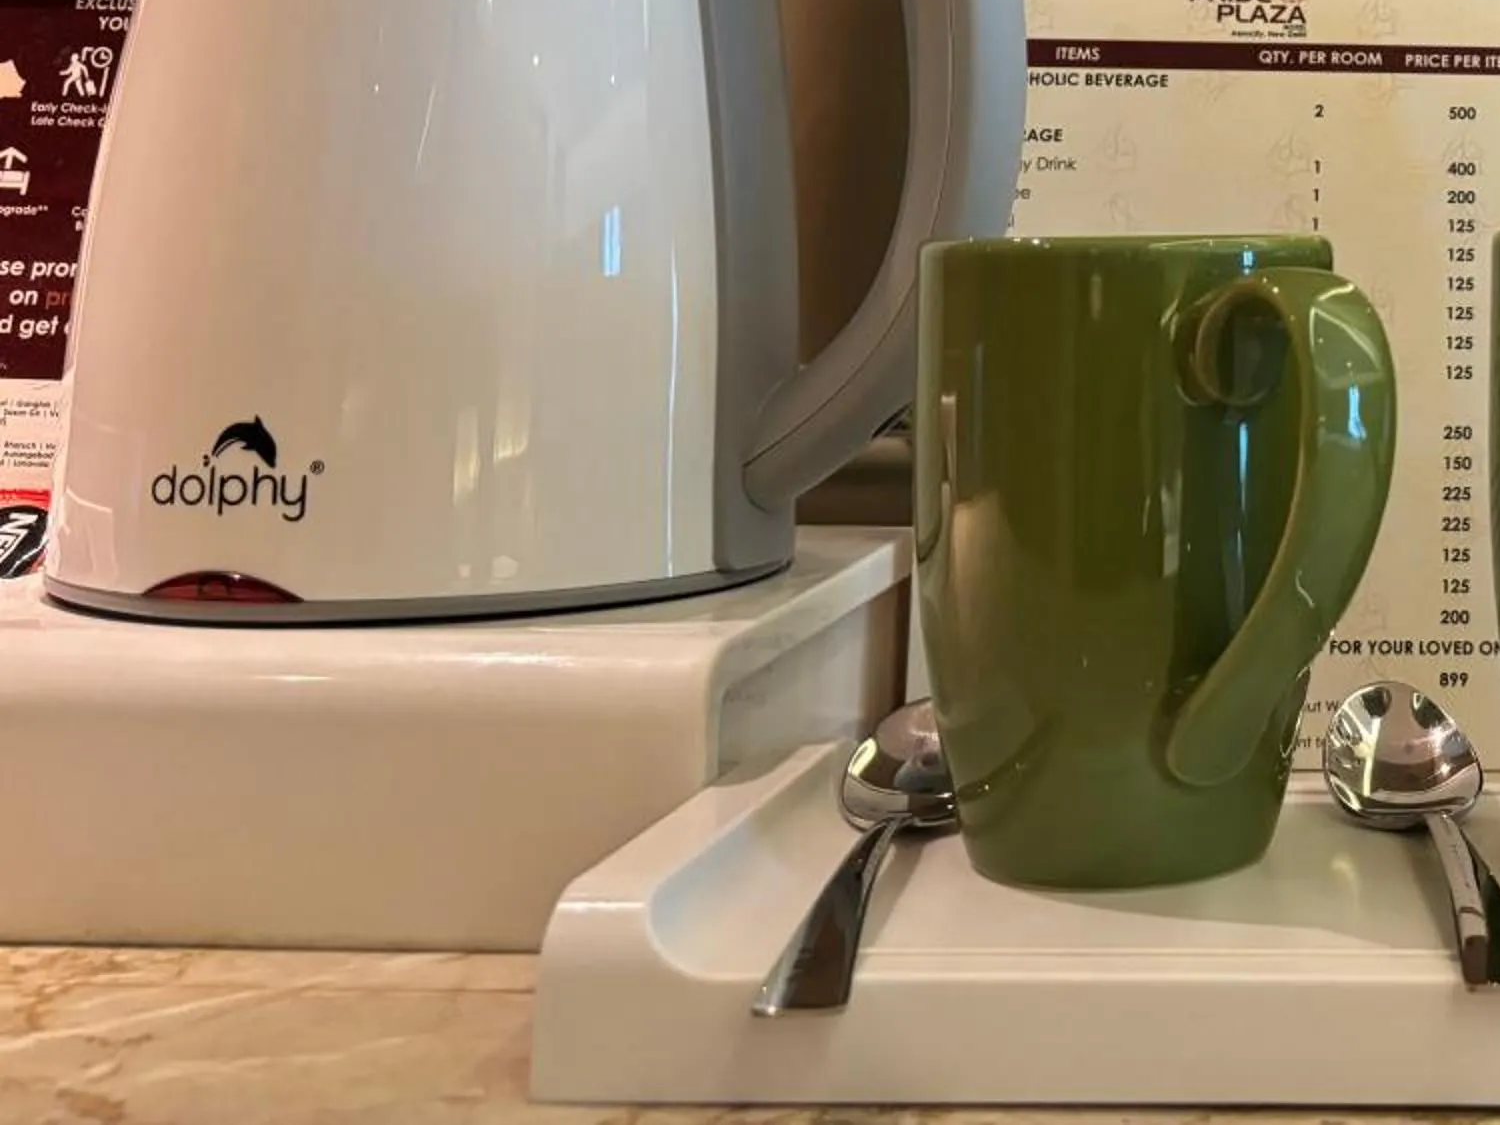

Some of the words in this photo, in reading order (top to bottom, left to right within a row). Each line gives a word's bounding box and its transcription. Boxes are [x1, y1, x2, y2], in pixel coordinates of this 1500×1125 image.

[1217, 4, 1306, 24] PLAZA
[1055, 46, 1100, 61] ITEMS
[1258, 50, 1294, 65] QTY.
[1299, 51, 1326, 65] PER
[1331, 51, 1383, 66] ROOM
[1405, 54, 1449, 68] PRICE
[1453, 55, 1480, 68] PER
[1029, 72, 1079, 86] HOLIC
[1085, 74, 1169, 88] BEVERAGE
[1314, 104, 1324, 118] 2
[1449, 106, 1477, 120] 500
[57, 116, 95, 128] Check
[1037, 156, 1077, 171] Drink
[1313, 160, 1321, 174] 1
[1447, 162, 1476, 176] 400
[1312, 188, 1320, 203] 1
[1447, 190, 1476, 204] 200
[1312, 217, 1319, 231] 1
[1448, 219, 1475, 233] 125
[1447, 248, 1475, 262] 125
[1447, 277, 1474, 291] 125
[9, 289, 39, 306] on
[1446, 306, 1474, 320] 125
[19, 315, 59, 340] get
[1446, 336, 1473, 350] 125
[1446, 365, 1473, 380] 125
[1443, 426, 1473, 440] 250
[1444, 456, 1473, 470] 150
[151, 464, 307, 522] dolphy
[1442, 486, 1471, 501] 225
[1441, 517, 1471, 532] 225
[1442, 548, 1471, 563] 125
[1442, 579, 1471, 594] 125
[1440, 610, 1470, 625] 200
[1329, 640, 1362, 656] FOR
[1368, 640, 1414, 656] YOUR
[1419, 640, 1473, 656] LOVED
[1439, 672, 1469, 687] 899
